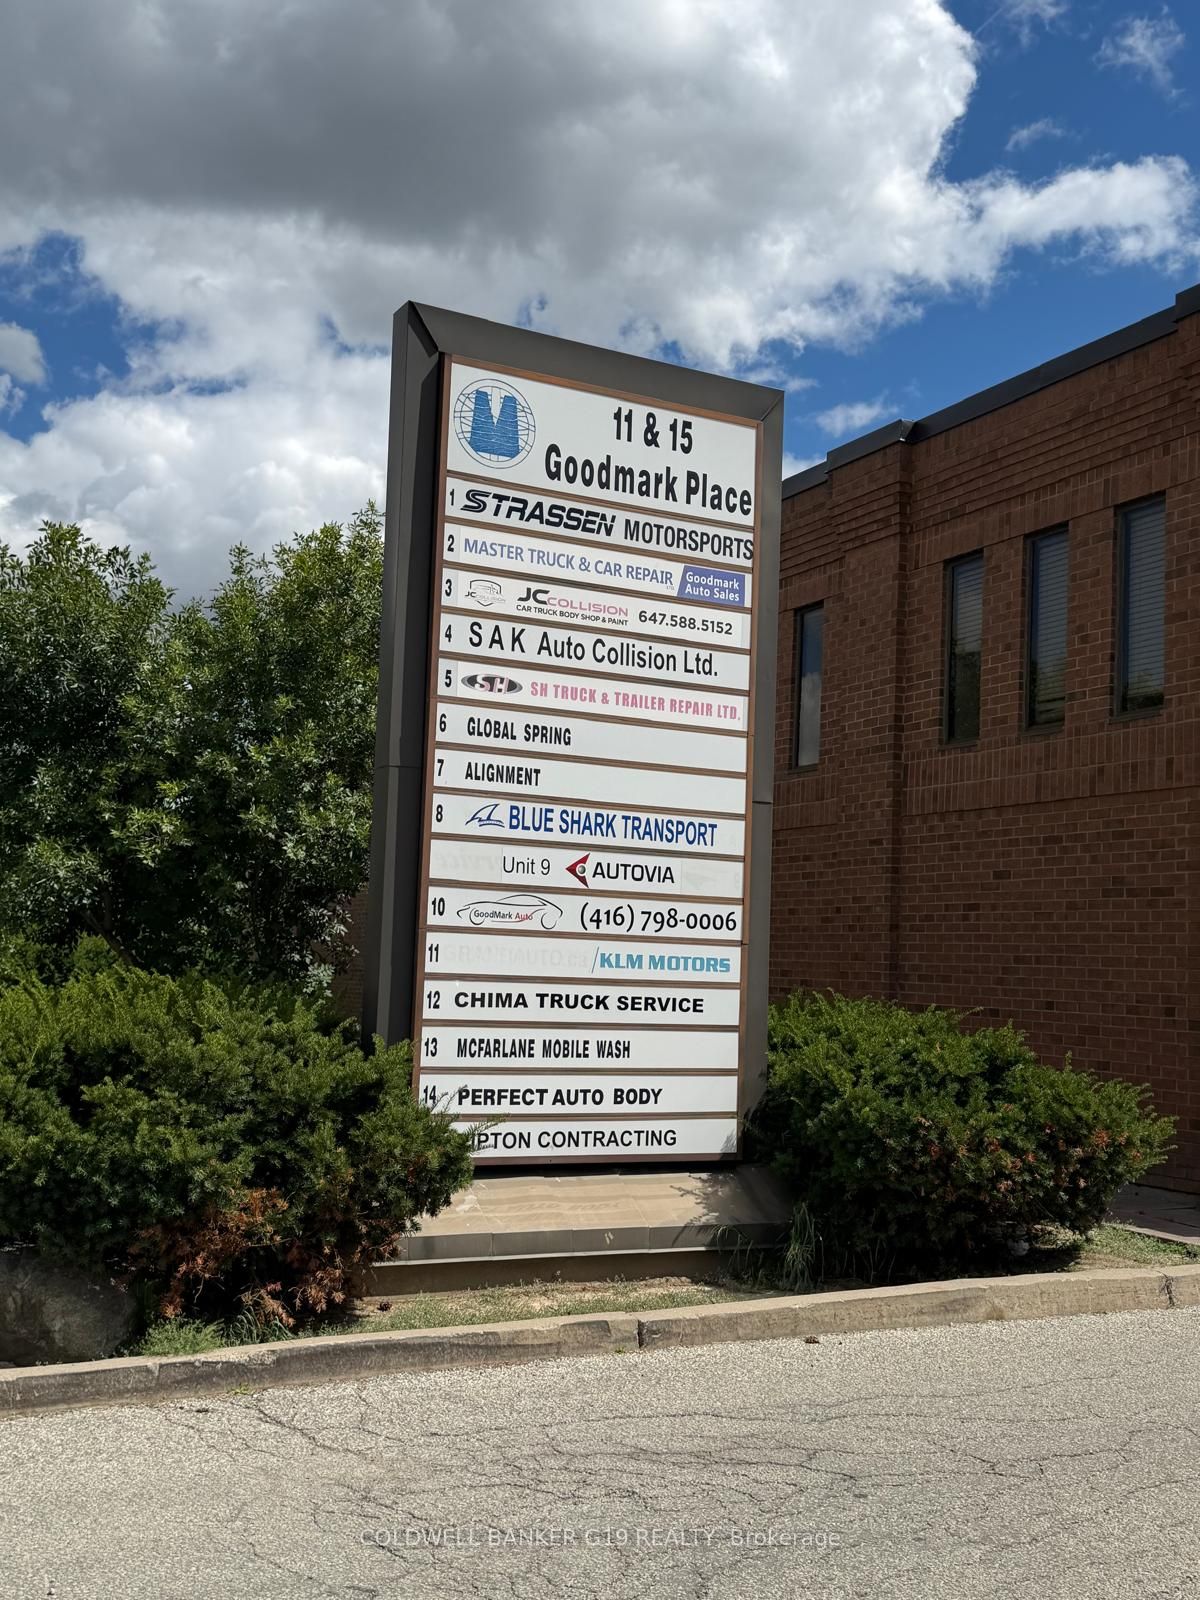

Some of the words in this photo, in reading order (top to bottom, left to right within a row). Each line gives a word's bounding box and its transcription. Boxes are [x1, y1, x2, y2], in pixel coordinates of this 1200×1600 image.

[613, 406, 633, 442] 11
[644, 412, 660, 448] &
[669, 418, 693, 454] 15
[545, 444, 678, 502] Goodmark
[686, 470, 752, 515] Place
[449, 488, 455, 506] 1
[460, 489, 617, 537] STRASSEN
[624, 519, 753, 560] MOTORSPORTS
[447, 534, 455, 552] 2
[464, 538, 524, 562] MASTER
[528, 547, 575, 571] TRUCK
[579, 556, 592, 573] &
[594, 559, 622, 579] CAR
[626, 565, 673, 586] REPAIR
[444, 578, 452, 597] 3
[686, 572, 739, 590] Goodmark
[685, 583, 710, 597] Auto
[713, 588, 740, 602] Sales
[516, 604, 532, 613] CAR
[533, 606, 558, 617] TRUCK
[559, 610, 579, 620] BODY
[580, 613, 600, 622] SHOP
[607, 617, 628, 626] PAINT
[638, 610, 733, 635] 647.588.5152
[444, 624, 452, 643] 4
[537, 632, 585, 661] Auto
[592, 638, 677, 673] Collision
[683, 649, 718, 677] Ltd.
[444, 669, 452, 687] 5
[530, 681, 548, 698] SH
[553, 684, 596, 704] TRUCK
[601, 689, 610, 705] &
[614, 691, 665, 712] TRAILER
[670, 697, 713, 718] REPAIR
[717, 702, 741, 721] LTD.
[439, 714, 447, 732] 6
[467, 717, 517, 741] GLOBAL
[524, 724, 572, 746] SPRING
[437, 759, 445, 777] 7
[465, 762, 541, 786] ALIGNMENT
[436, 805, 443, 823] 8
[509, 805, 554, 833] BLUE
[559, 809, 616, 838] SHARK
[621, 815, 718, 847] TRANSPORT
[502, 855, 536, 876] Unit
[541, 858, 551, 876] 9
[592, 861, 675, 884] AUTOVIA
[431, 897, 446, 917] 10
[474, 910, 513, 920] GoodMark
[514, 912, 534, 921] Auto
[641, 908, 737, 933] 798-0006
[428, 943, 439, 963] 11
[599, 952, 644, 970] KLM
[648, 955, 731, 973] MOTORS
[427, 990, 441, 1010] 12
[454, 991, 529, 1009] CHIMA
[535, 993, 610, 1011] TRUCK
[616, 995, 704, 1013] SERVICE
[424, 1037, 438, 1057] 13
[457, 1038, 535, 1058] MCFARLANE
[542, 1039, 590, 1059] MOBILE
[597, 1040, 631, 1059] WASH
[423, 1085, 437, 1105] 14
[458, 1088, 548, 1106] PERFECT
[552, 1088, 604, 1106] AUTO
[613, 1088, 663, 1105] BODY
[537, 1129, 677, 1148] CONTRACTING
